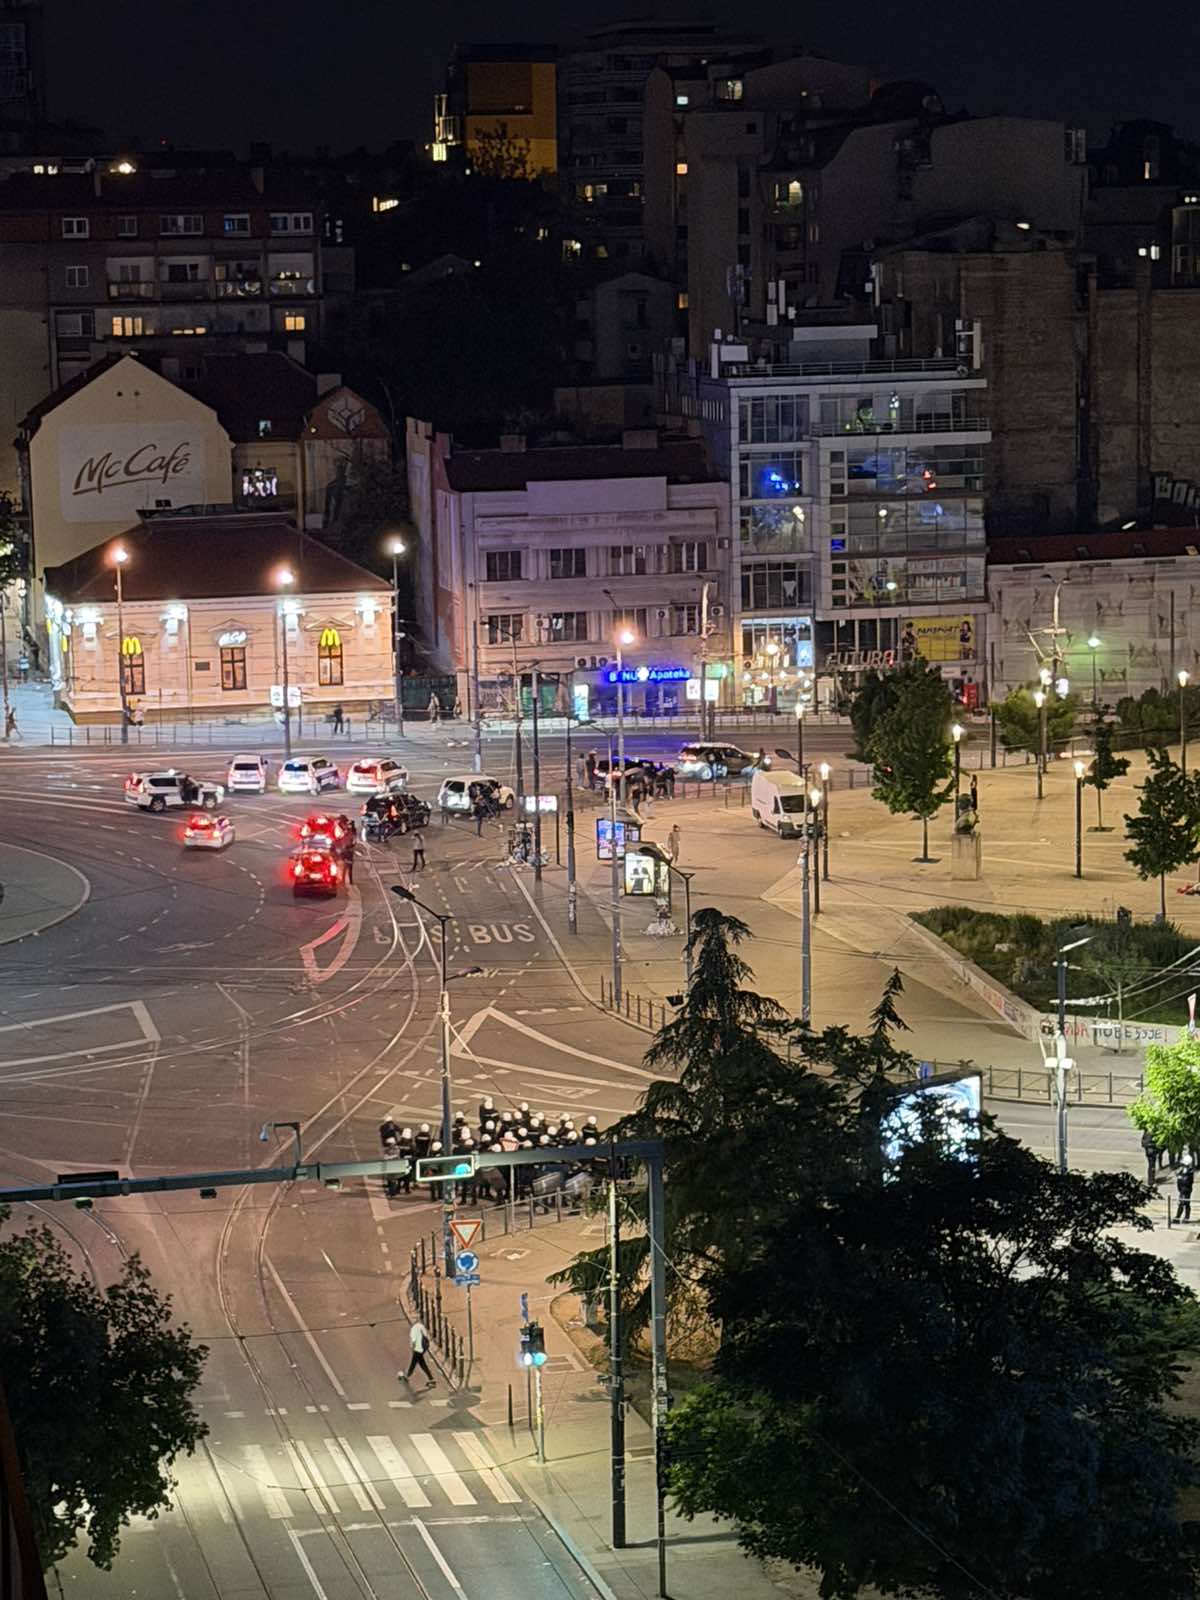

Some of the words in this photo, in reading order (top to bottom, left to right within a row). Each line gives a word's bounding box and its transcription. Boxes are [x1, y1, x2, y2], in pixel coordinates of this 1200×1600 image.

[73, 441, 191, 495] McCafé
[609, 671, 637, 682] BNU
[468, 924, 535, 944] BUS
